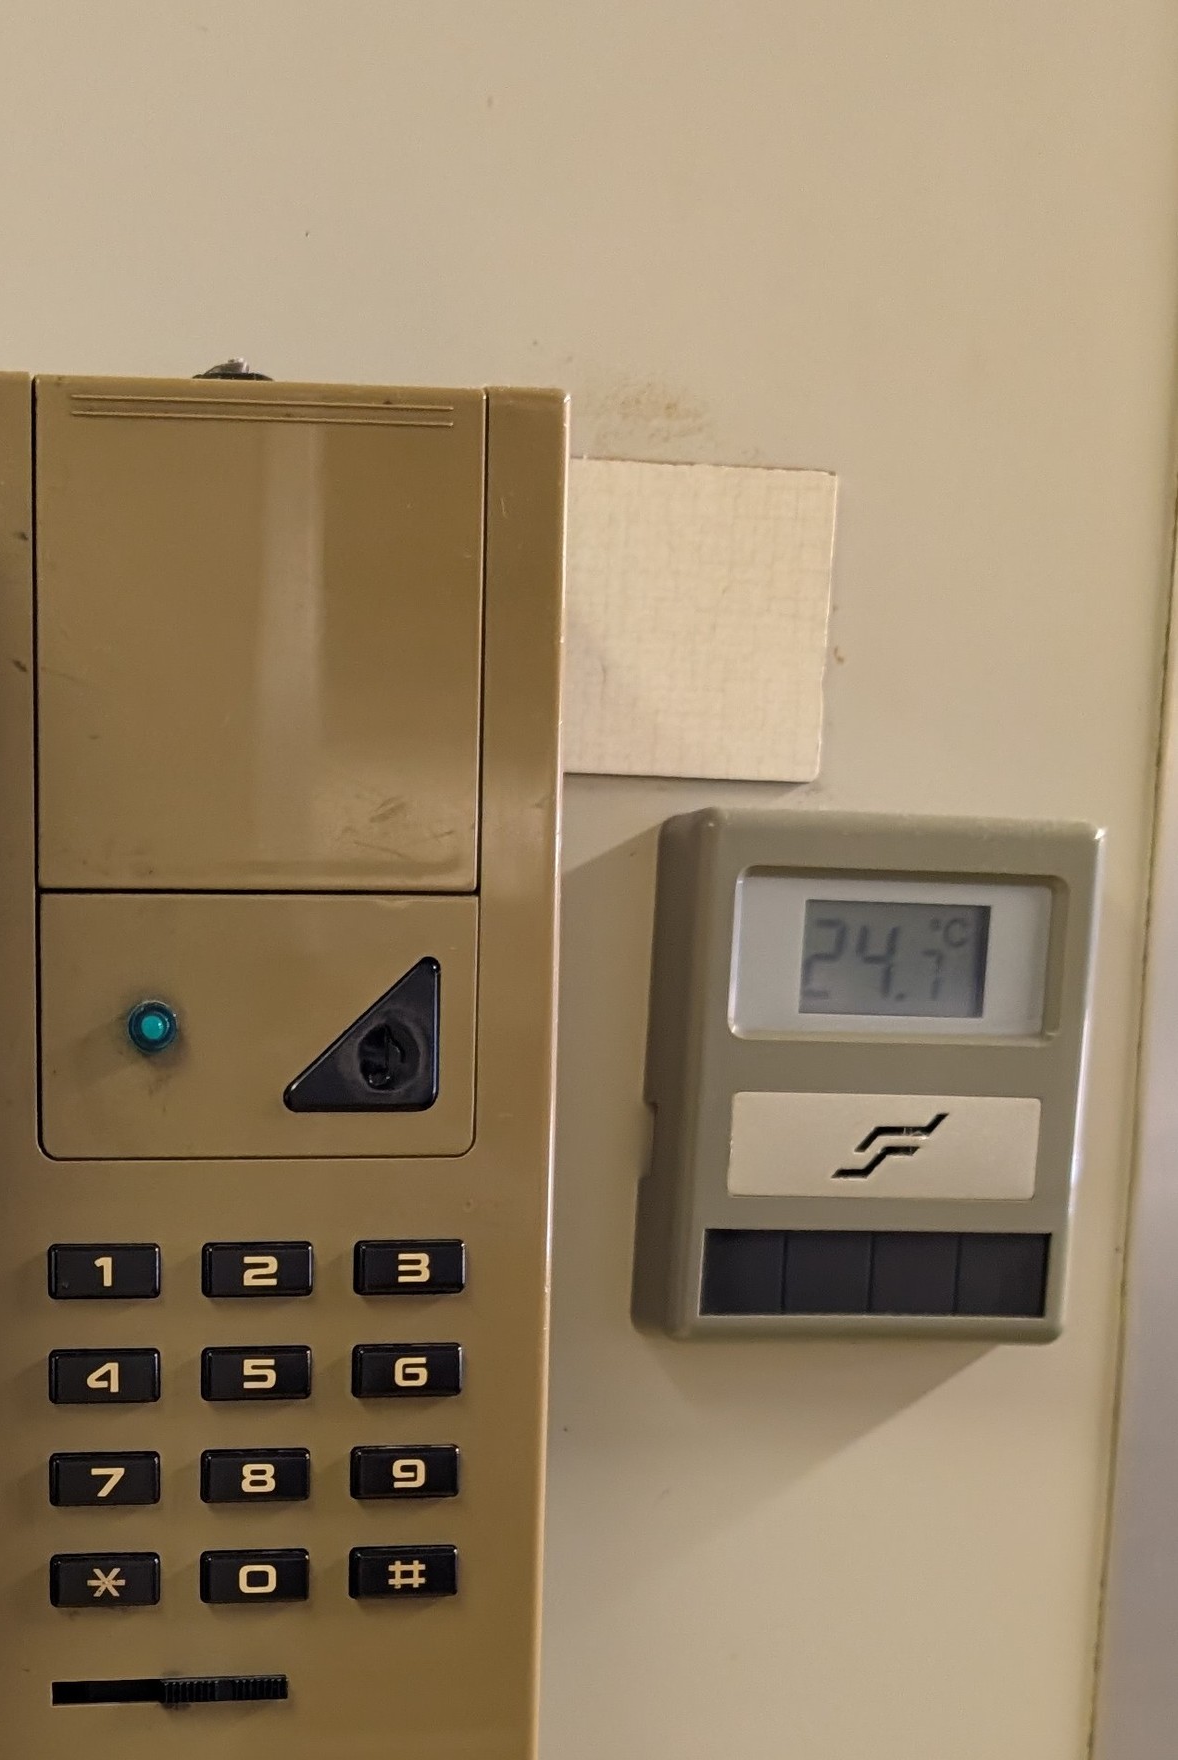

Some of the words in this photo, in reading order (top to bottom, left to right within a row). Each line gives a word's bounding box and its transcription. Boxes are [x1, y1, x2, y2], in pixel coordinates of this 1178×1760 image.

[94, 1256, 113, 1287] 1
[243, 1255, 278, 1286] 2
[397, 1252, 430, 1283] 3
[86, 1362, 119, 1393] 4
[243, 1358, 277, 1389] 5
[394, 1357, 428, 1387] 6
[91, 1467, 125, 1497] 7
[241, 1463, 276, 1493] 8
[392, 1459, 426, 1489] 9
